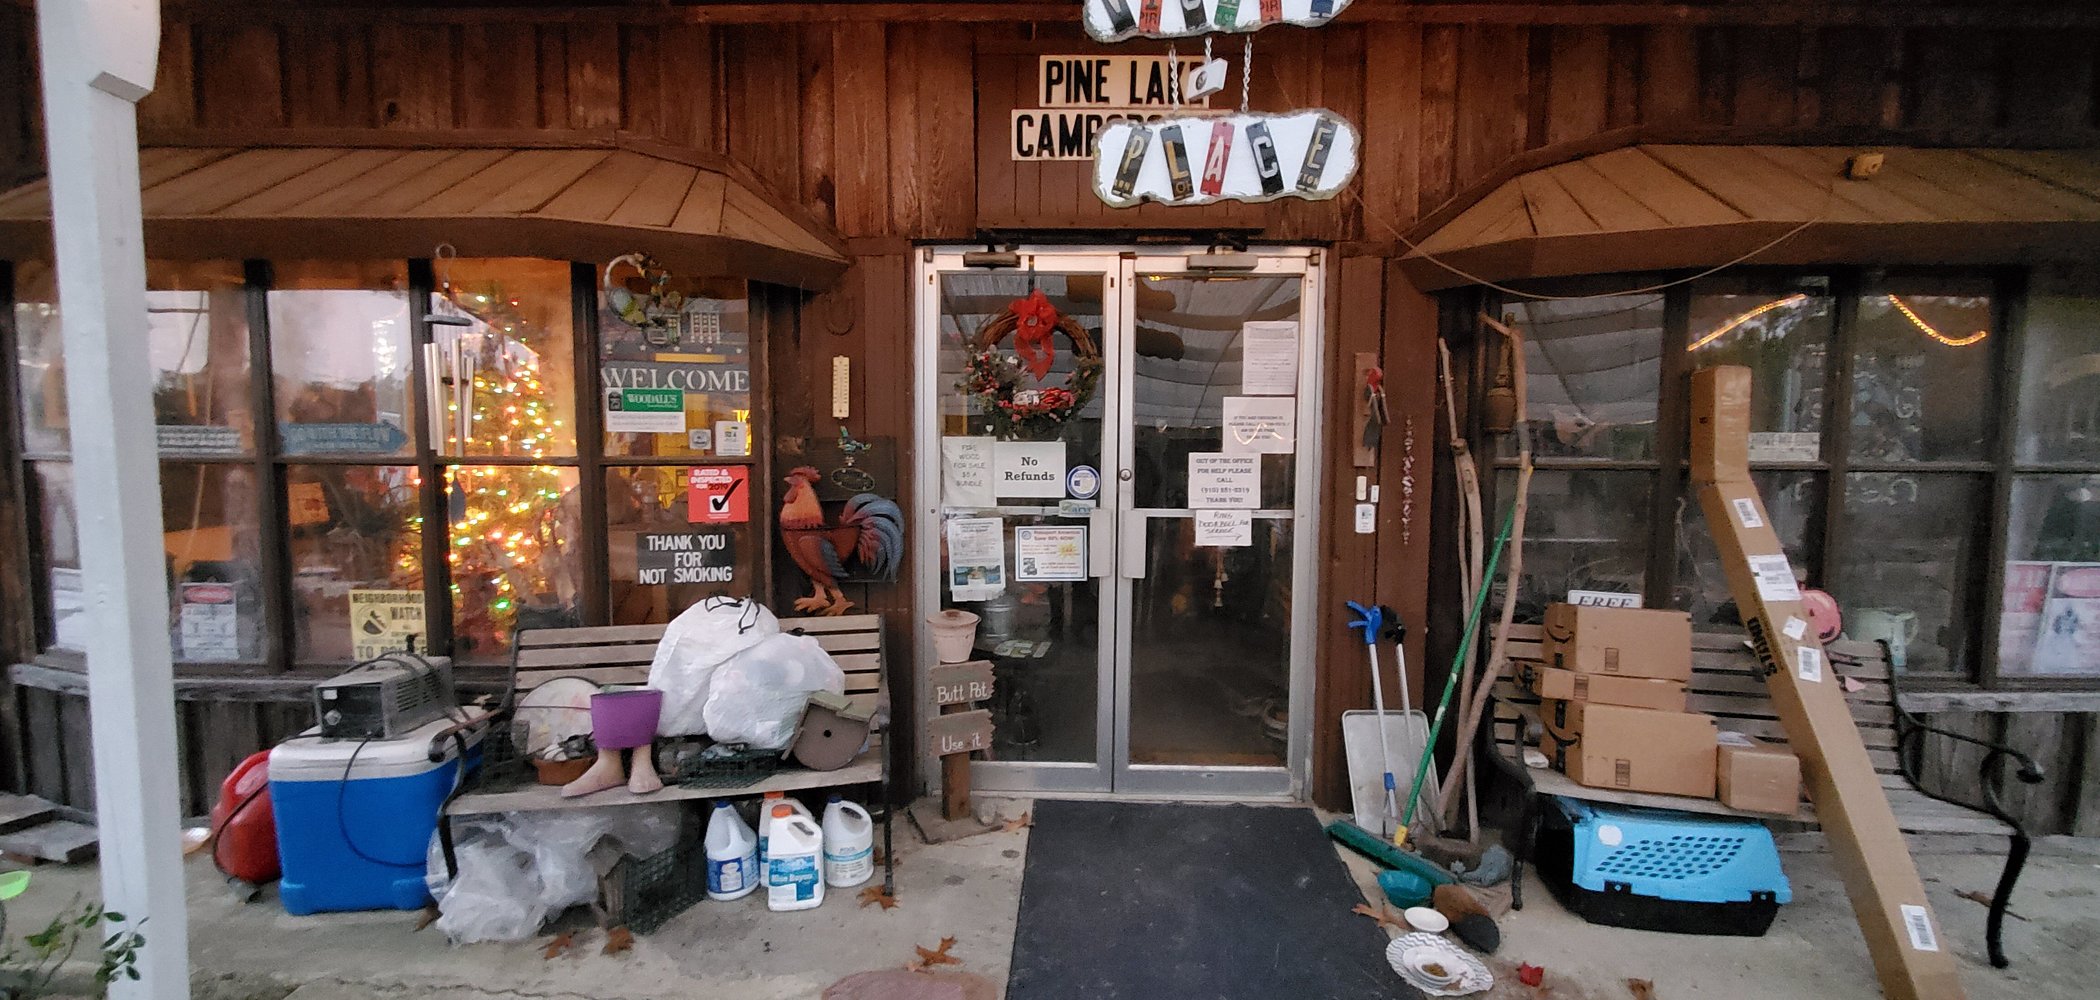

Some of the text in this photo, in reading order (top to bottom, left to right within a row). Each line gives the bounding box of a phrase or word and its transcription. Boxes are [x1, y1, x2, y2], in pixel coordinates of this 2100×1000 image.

[1045, 60, 1110, 103] PINE
[1122, 126, 1332, 182] PLACE
[601, 368, 749, 392] WELCOME
[1020, 457, 1038, 466] No
[1004, 471, 1055, 481] Refunds
[646, 534, 726, 551] THANK YOU
[674, 552, 702, 567] FOR
[639, 566, 733, 584] NOT SMOKING
[390, 607, 422, 620] WATCH
[937, 681, 988, 704] Butt Pot
[942, 732, 982, 752] Use it
